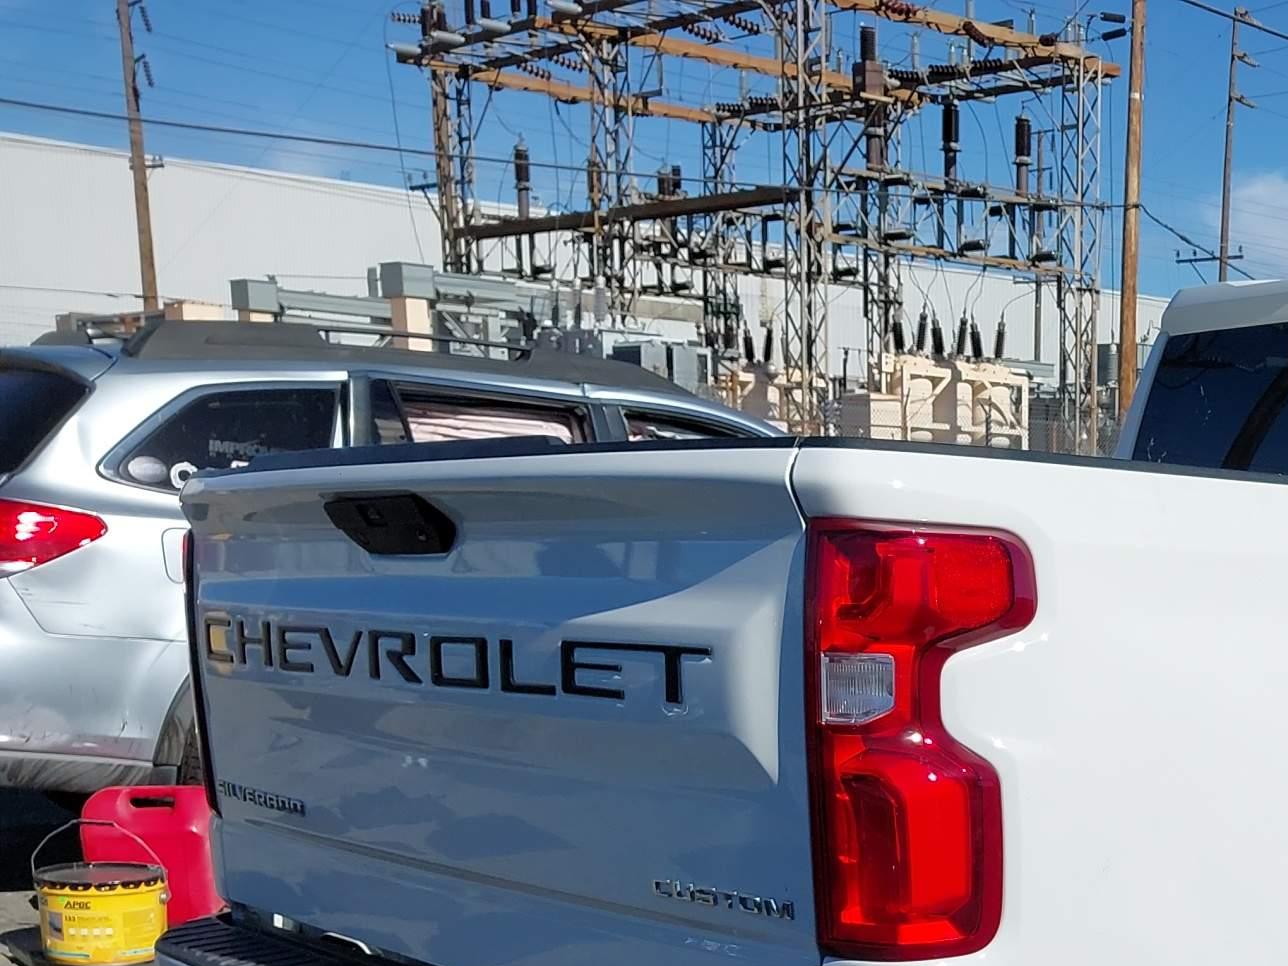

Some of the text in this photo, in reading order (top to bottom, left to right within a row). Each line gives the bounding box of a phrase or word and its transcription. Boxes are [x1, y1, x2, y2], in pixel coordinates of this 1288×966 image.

[204, 616, 713, 704] CHEVROLET
[217, 781, 306, 817] SILVERADO
[653, 879, 796, 920] CUSTOM
